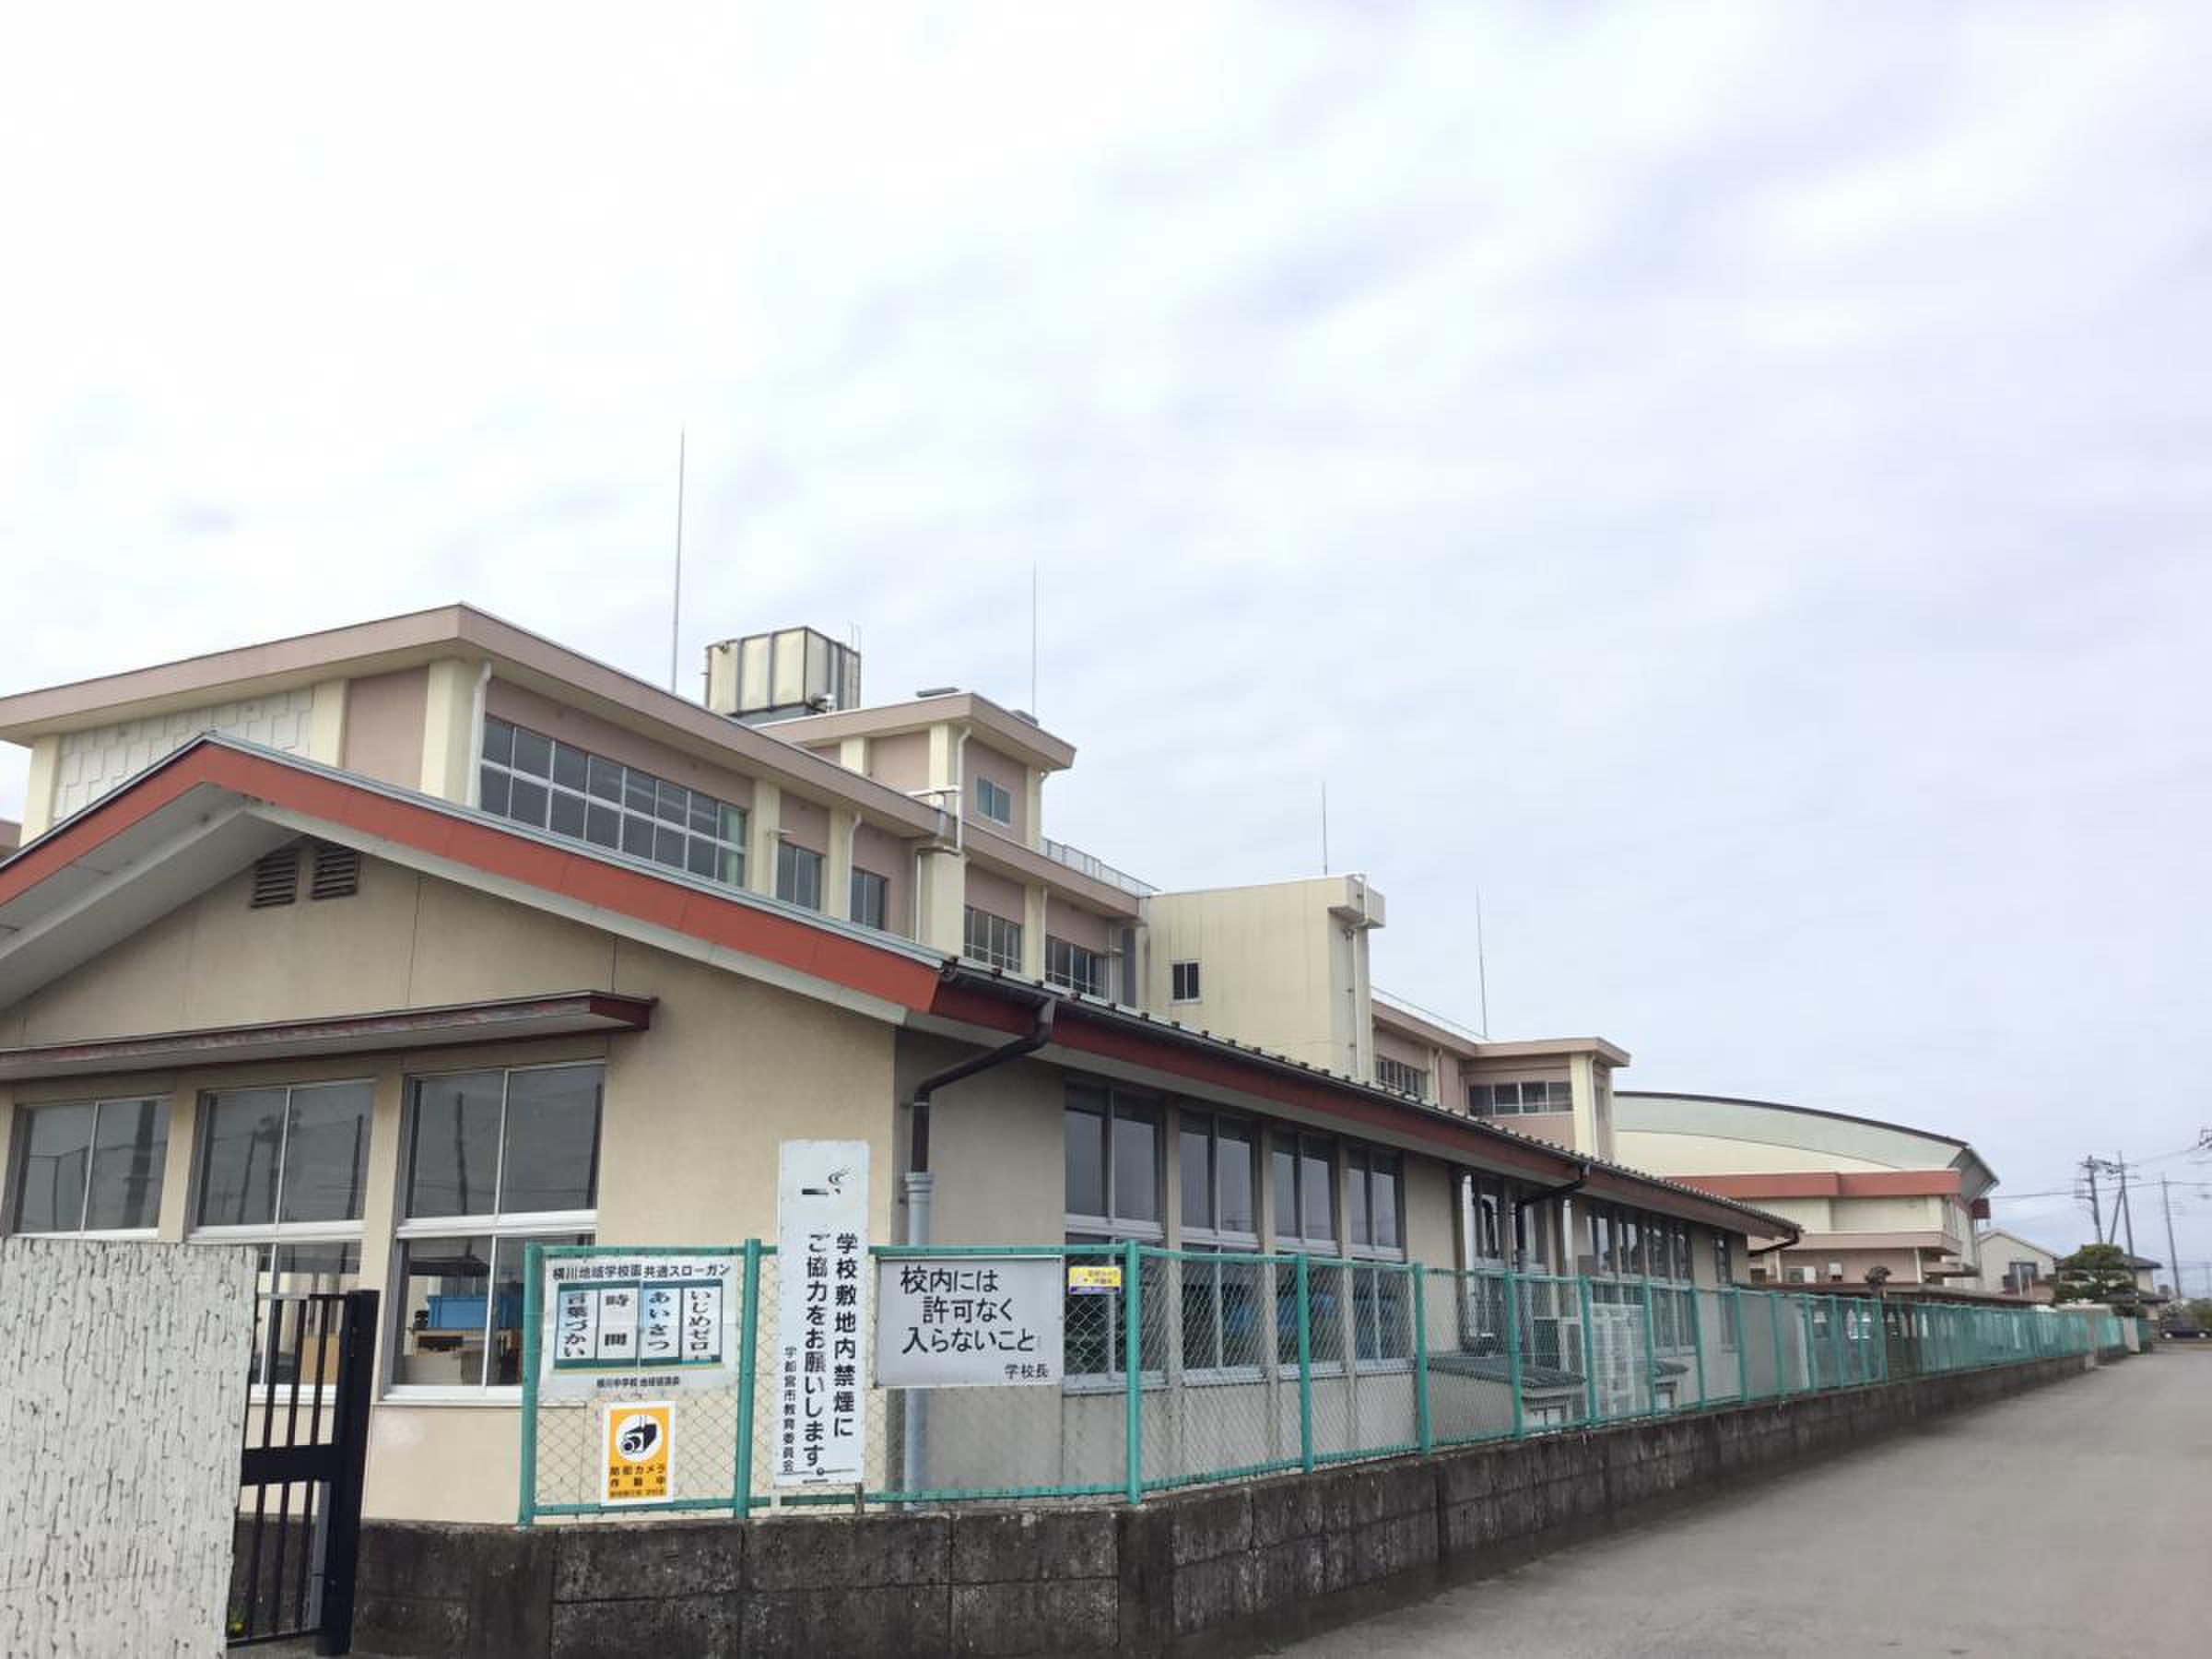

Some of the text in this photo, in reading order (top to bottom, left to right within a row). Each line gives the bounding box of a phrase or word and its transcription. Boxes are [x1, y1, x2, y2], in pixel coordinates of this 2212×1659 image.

[900, 1265, 998, 1295] 校内には
[648, 1291, 670, 1351] あいさつ
[923, 1295, 1013, 1324] 許可なく
[833, 1232, 857, 1438] 学校敷地内禁煙に
[901, 1326, 1035, 1355] 入らないこと
[804, 1234, 829, 1476] ご協力をお願いします。
[1004, 1364, 1049, 1379] 学校長
